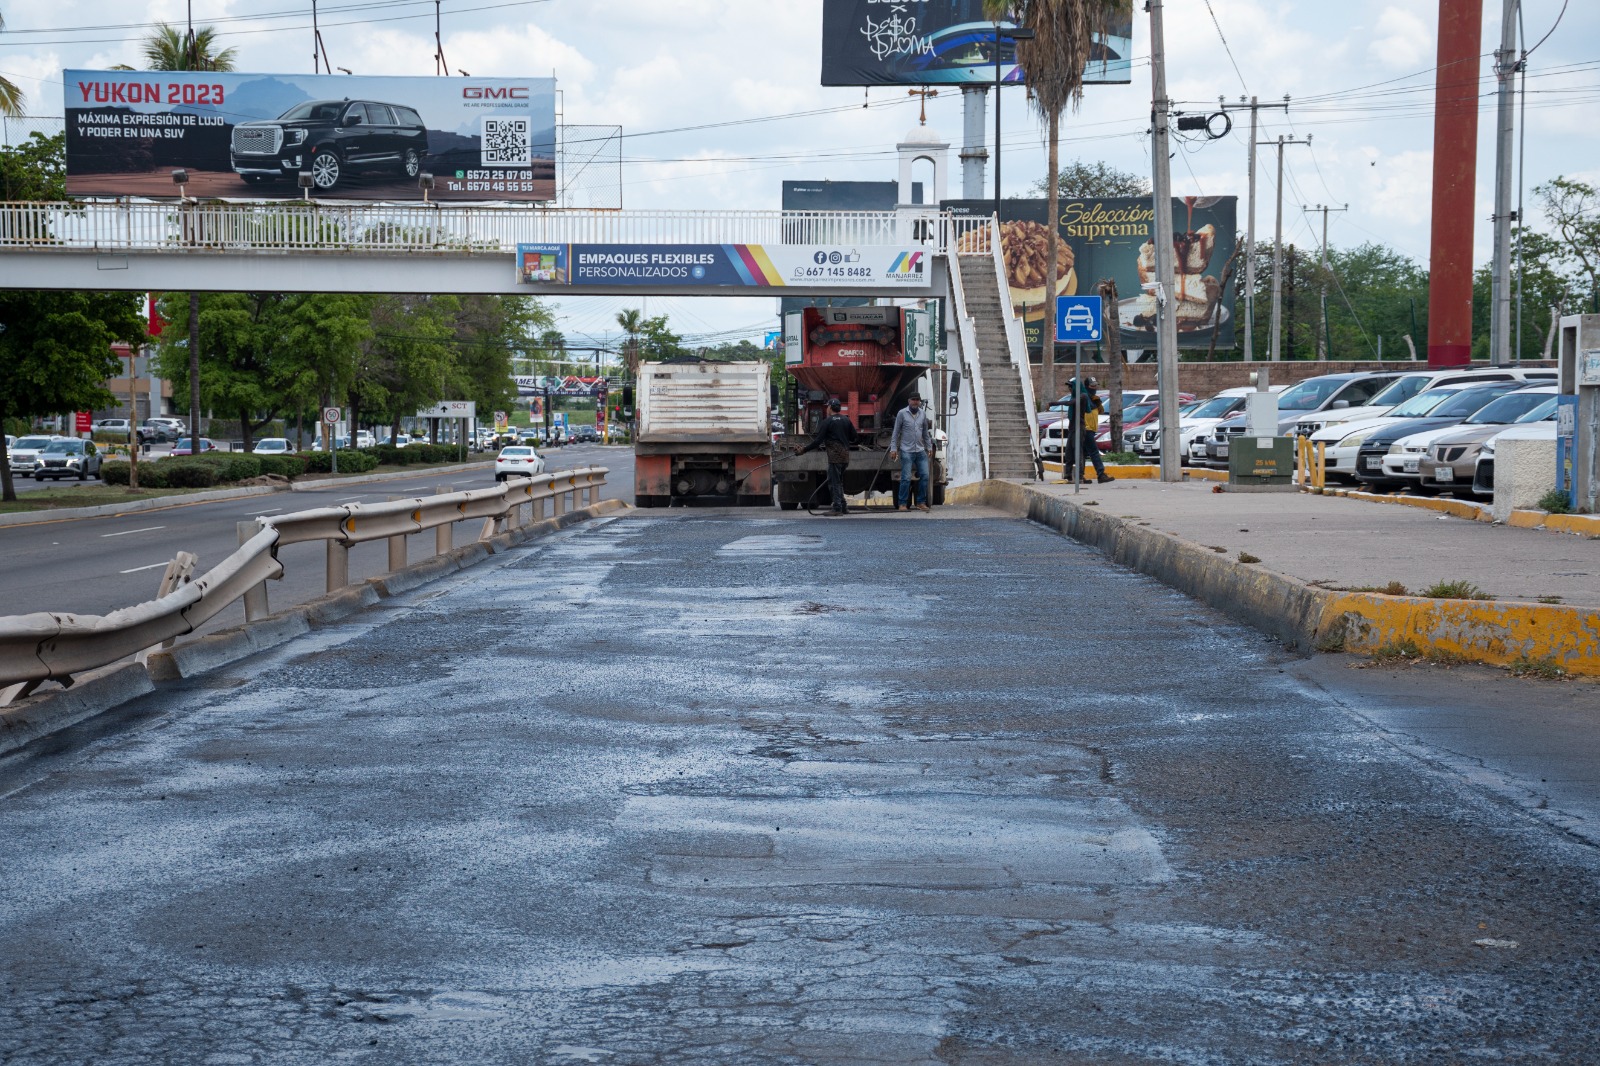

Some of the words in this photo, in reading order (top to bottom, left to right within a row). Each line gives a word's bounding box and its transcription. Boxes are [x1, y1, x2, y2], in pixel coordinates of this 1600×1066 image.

[78, 82, 160, 103] YUKON
[168, 84, 224, 104] 2023
[463, 88, 529, 99] GMC
[78, 112, 120, 124] MÁXIMA
[122, 113, 180, 126] EXPRESIÓN
[182, 116, 196, 126] DE
[198, 116, 224, 126] LUJO
[78, 127, 86, 136] Y
[87, 127, 122, 138] PODER
[124, 128, 137, 138] EN
[140, 128, 162, 138] UNA
[164, 128, 184, 138] SUV
[467, 170, 490, 180] 6673
[492, 170, 504, 180] 25
[506, 170, 518, 180] 07
[520, 170, 533, 180] 09
[448, 182, 464, 190] Tel.
[467, 182, 490, 191] 6678
[492, 182, 504, 191] 46
[507, 182, 518, 191] 55
[521, 182, 533, 191] 55
[1060, 203, 1154, 226] Selección
[1067, 224, 1148, 241] suprema
[578, 253, 648, 264] EMPAQUES
[652, 254, 714, 264] FLEXIBLES
[579, 267, 688, 277] PERSONALIZADOS
[806, 268, 824, 276] 667
[827, 268, 844, 276] 145
[847, 268, 871, 276] 8482
